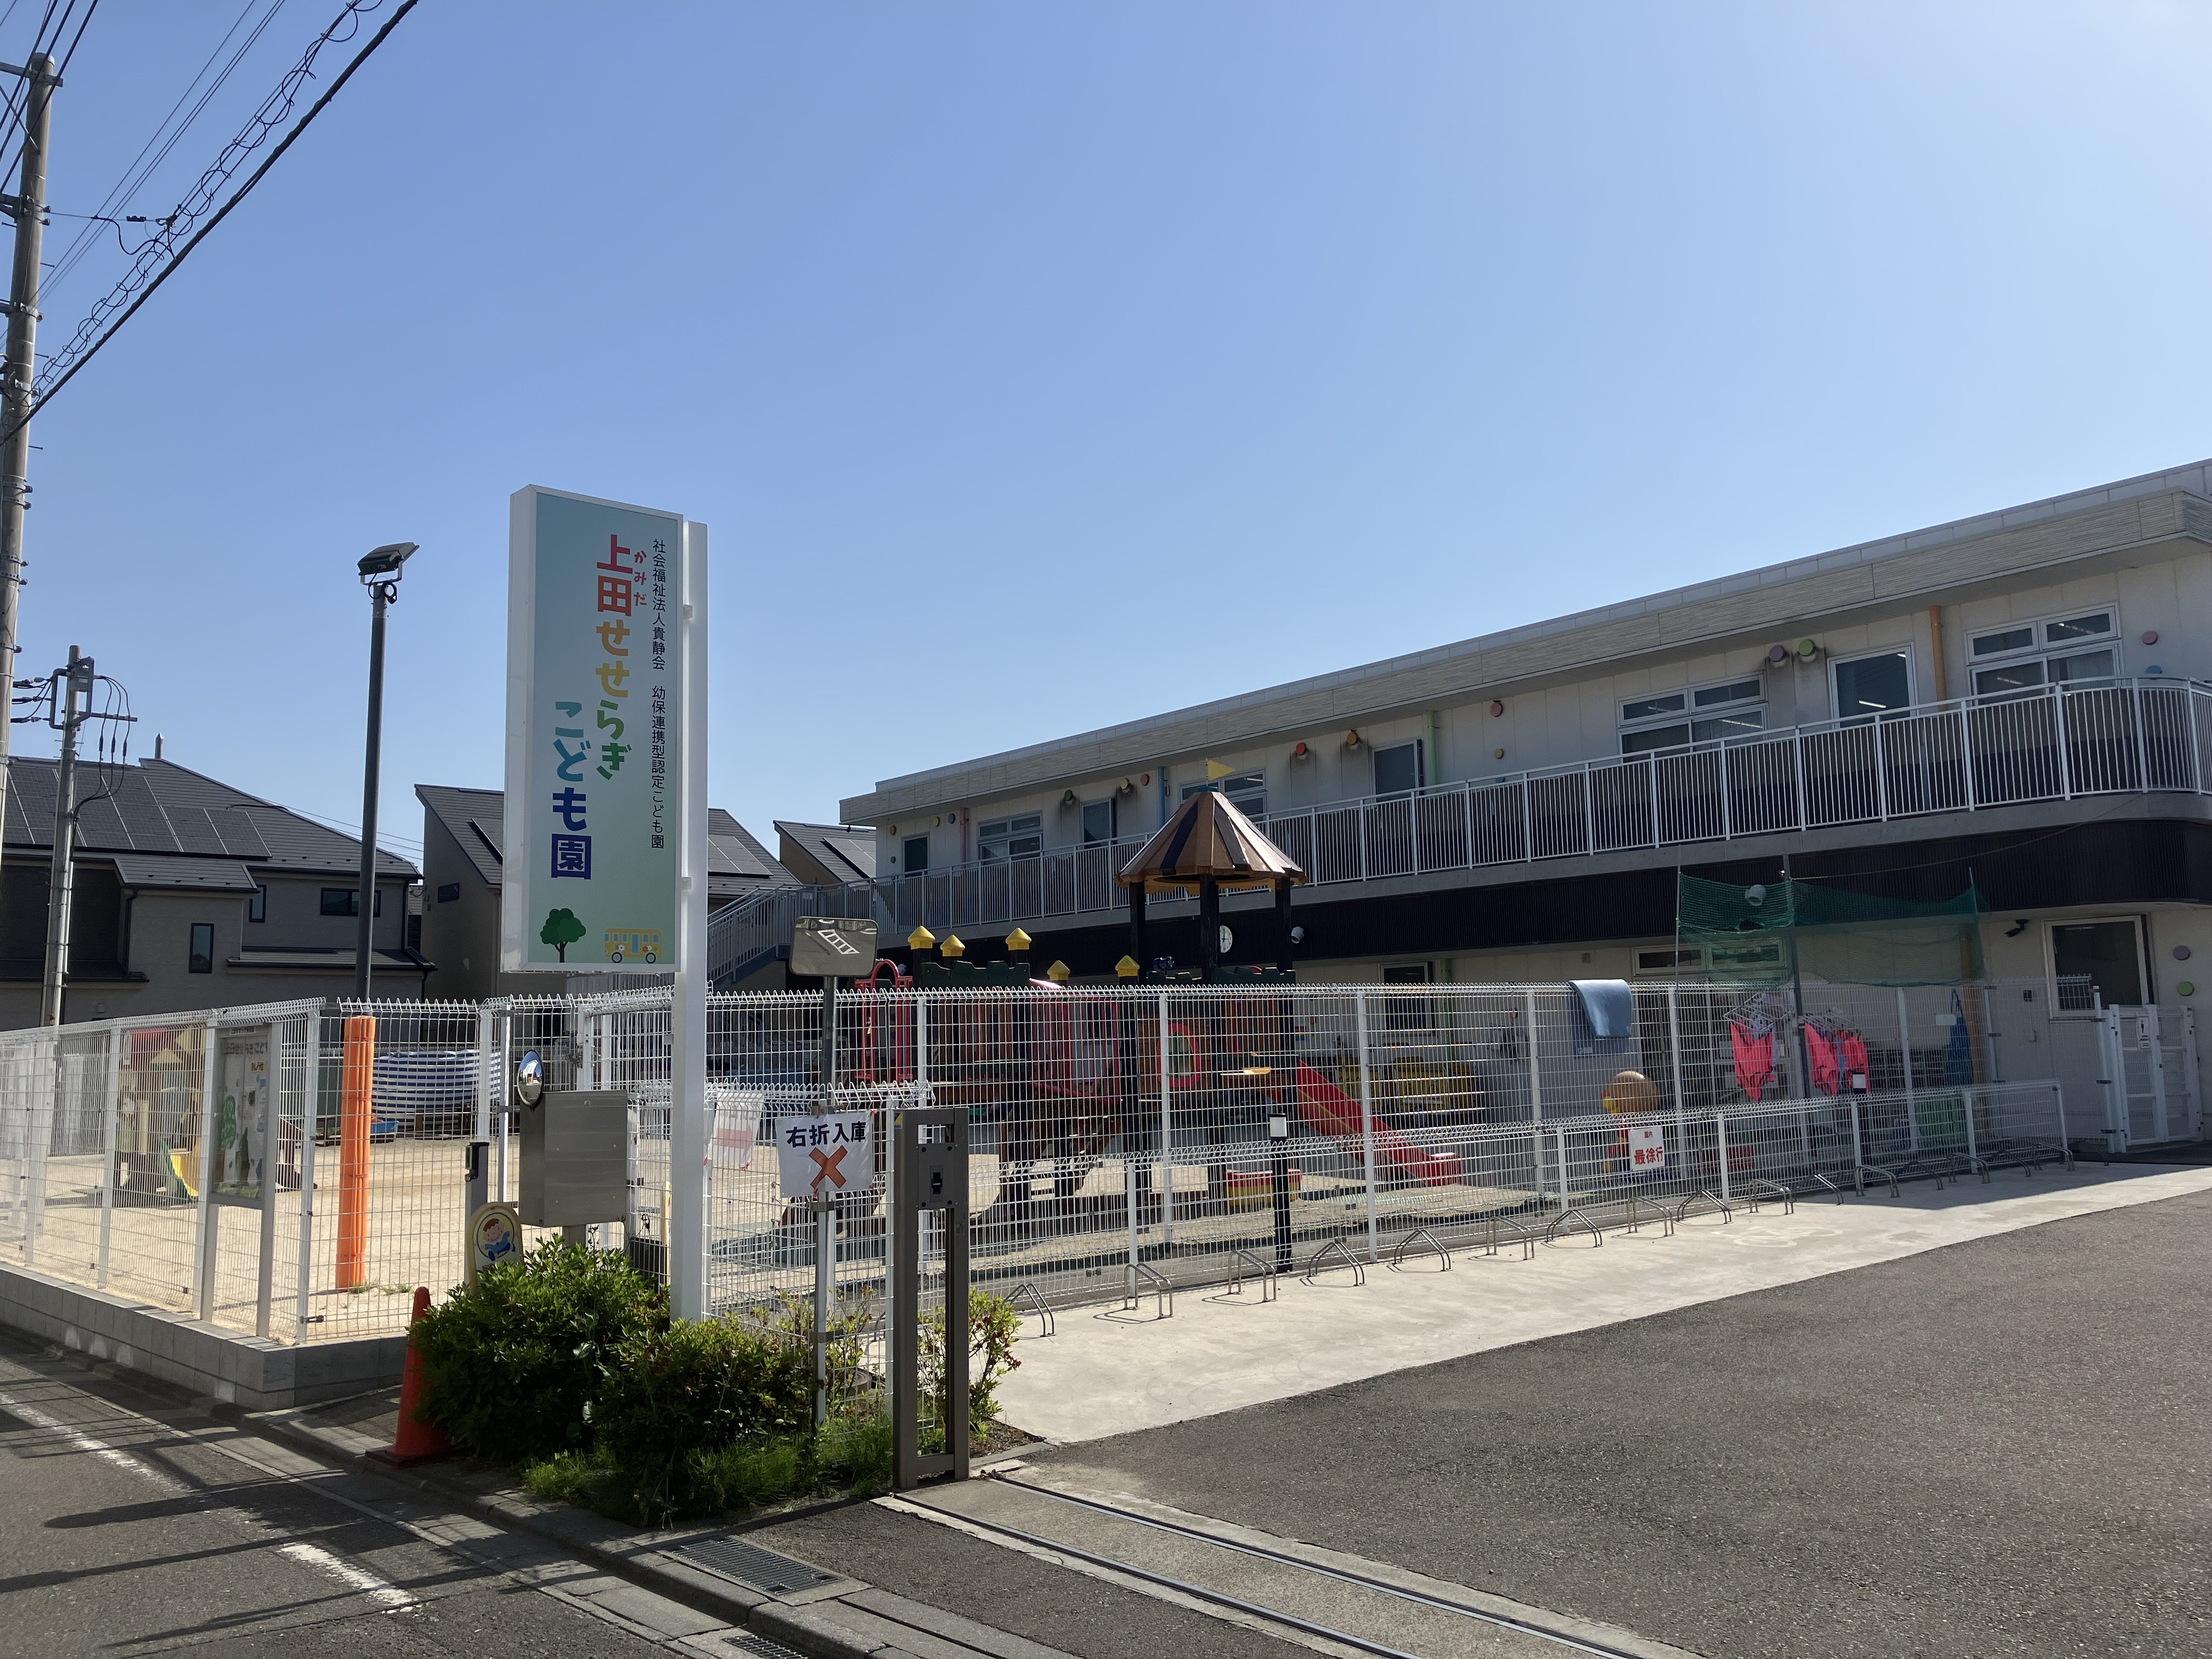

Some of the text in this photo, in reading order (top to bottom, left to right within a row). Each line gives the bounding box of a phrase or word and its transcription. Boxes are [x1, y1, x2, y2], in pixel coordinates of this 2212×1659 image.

[634, 550, 647, 606] かみだ
[596, 534, 633, 780] 上田せせらぎ
[651, 539, 666, 849] 社会福祉法人貴静会 幼保連携型認定こども園
[551, 702, 592, 880] こども園
[786, 1121, 867, 1149] 右折入庫
[1634, 1146, 1663, 1165] 最徐行
